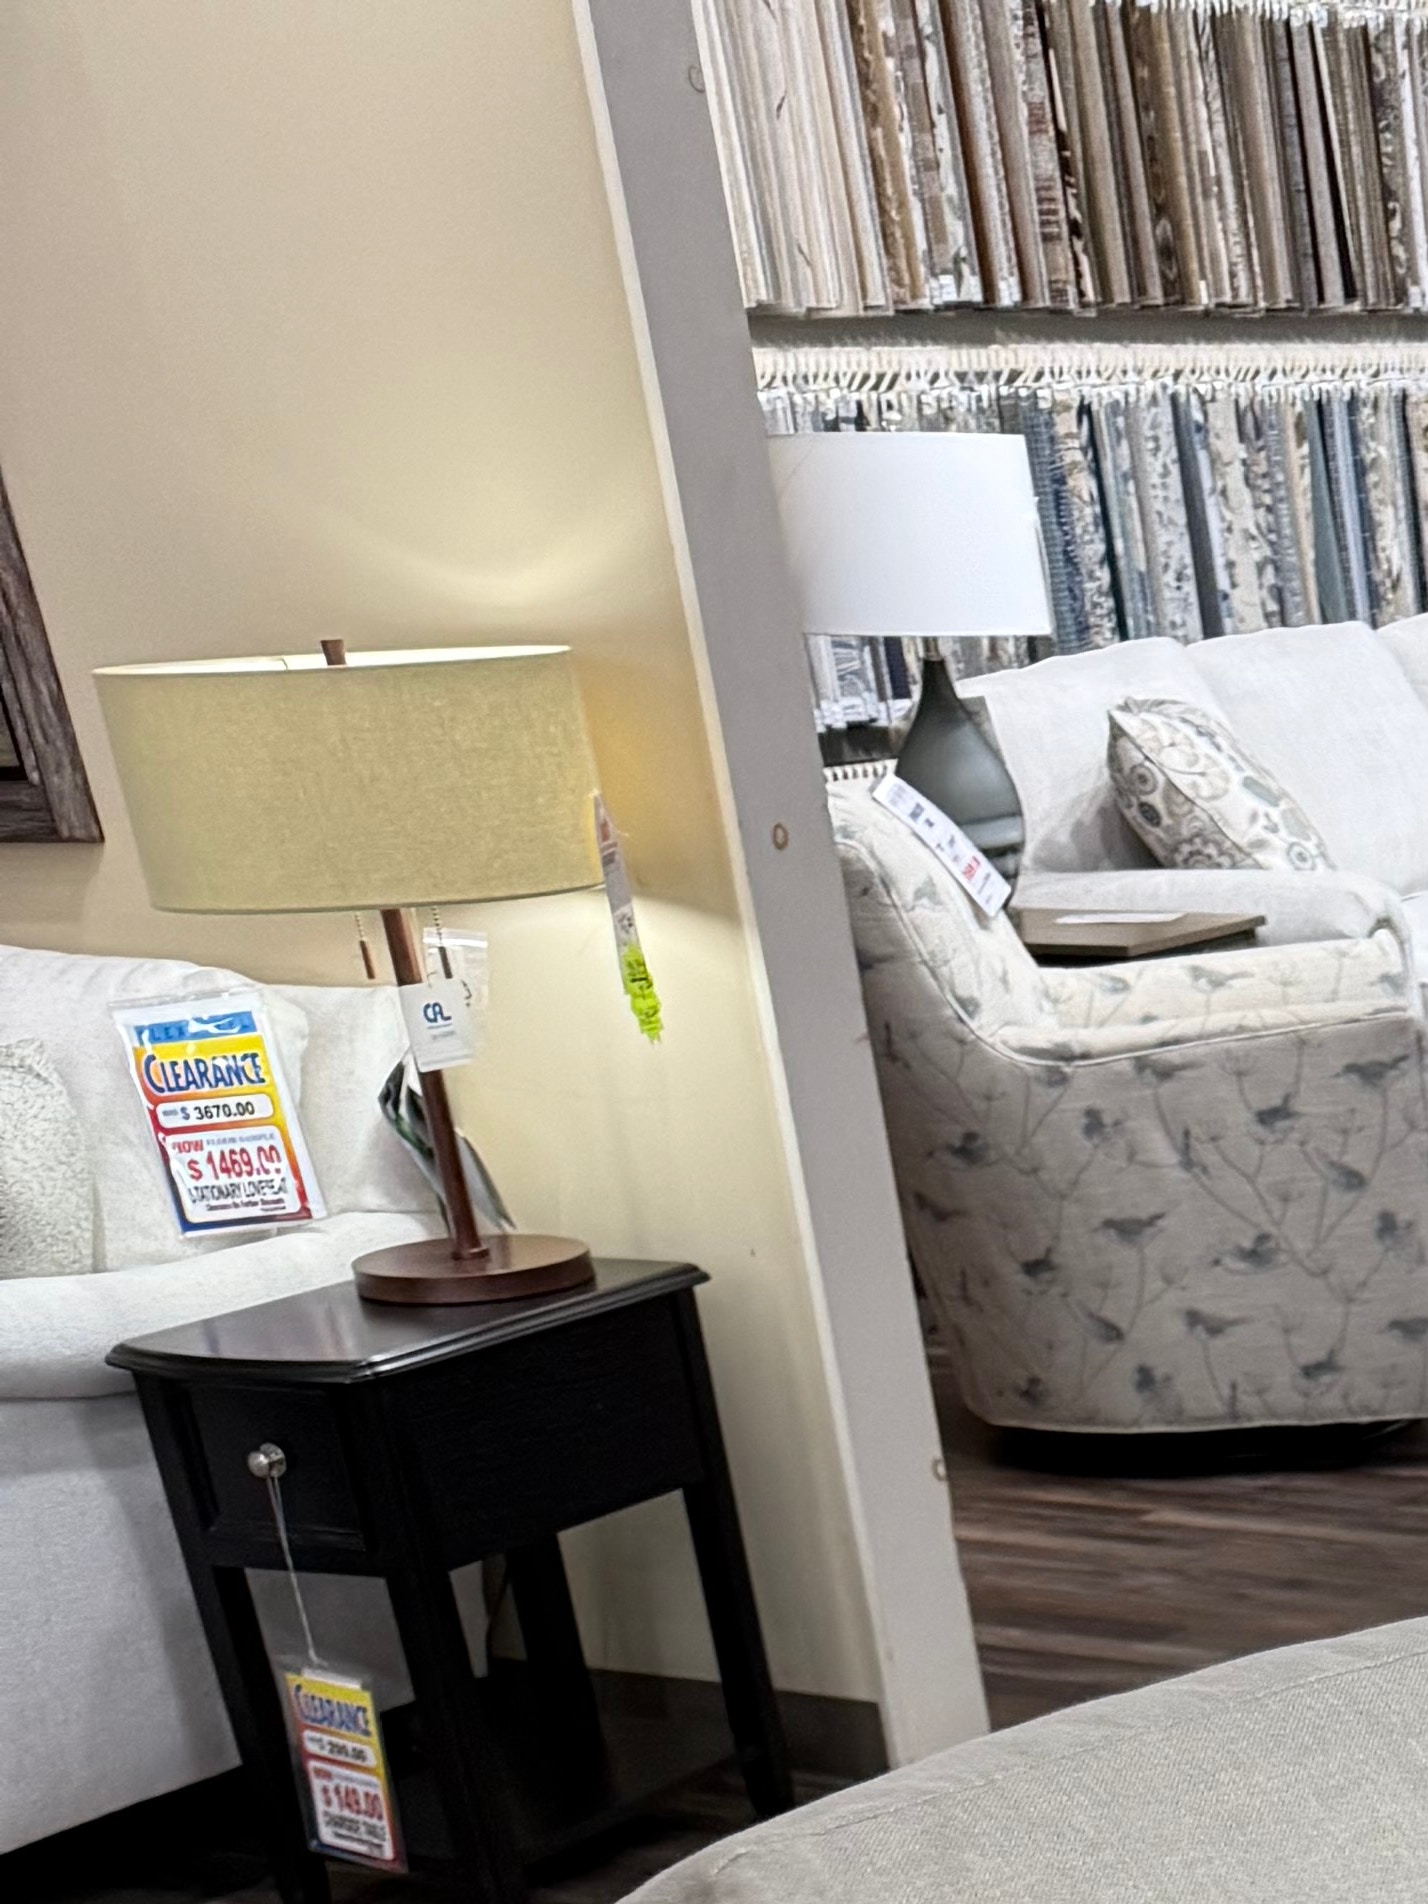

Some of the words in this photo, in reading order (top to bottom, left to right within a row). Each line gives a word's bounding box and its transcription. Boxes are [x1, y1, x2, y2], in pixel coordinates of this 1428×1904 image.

[144, 1052, 266, 1093] CLEARANCE
[193, 1101, 255, 1121] 3670.00
[187, 1158, 204, 1181] $
